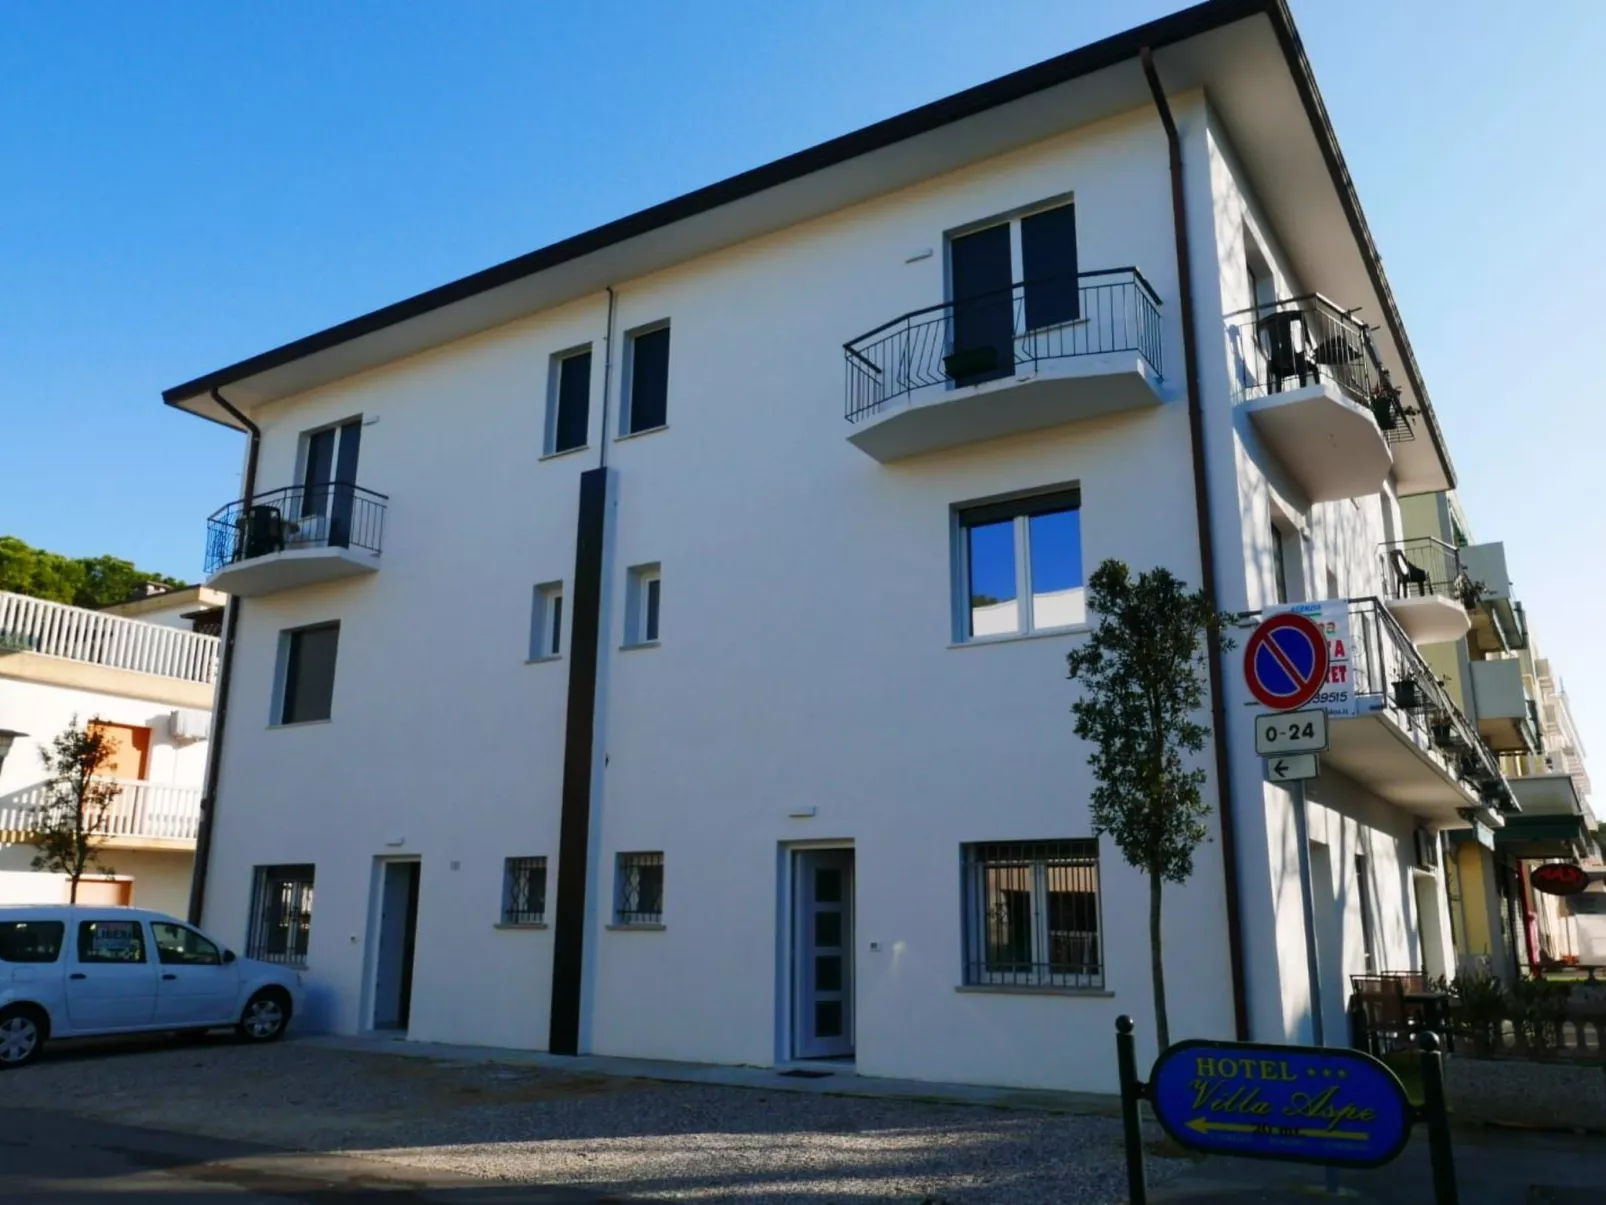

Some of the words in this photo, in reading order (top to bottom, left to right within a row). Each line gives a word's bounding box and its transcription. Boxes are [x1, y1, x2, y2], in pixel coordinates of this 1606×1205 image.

[1266, 722, 1314, 742] 0-24
[1196, 1057, 1297, 1081] HOTEL
[1189, 1079, 1273, 1115] Villa
[1284, 1086, 1376, 1132] Aspe
